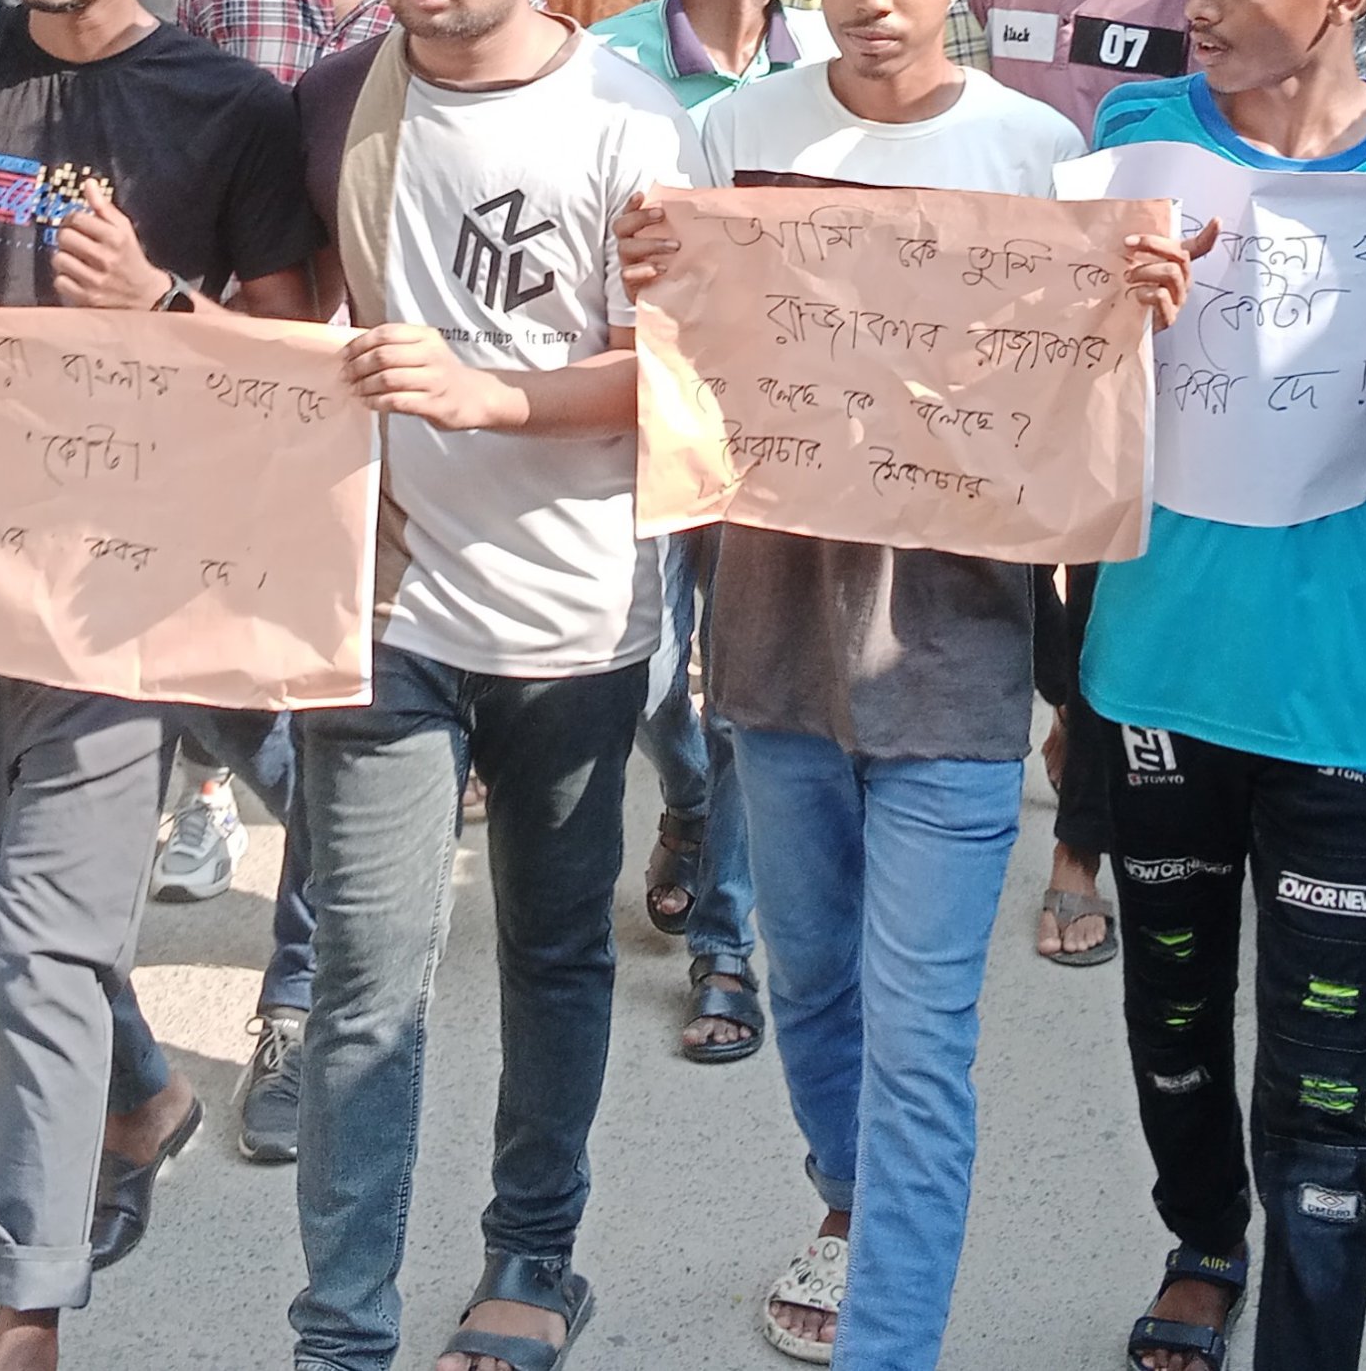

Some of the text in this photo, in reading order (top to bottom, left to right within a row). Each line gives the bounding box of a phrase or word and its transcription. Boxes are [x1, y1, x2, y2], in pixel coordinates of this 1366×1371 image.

[1099, 23, 1150, 68] 07
[694, 205, 875, 263] আমি
[962, 239, 1052, 290] তুমি
[1310, 886, 1338, 909] OR
